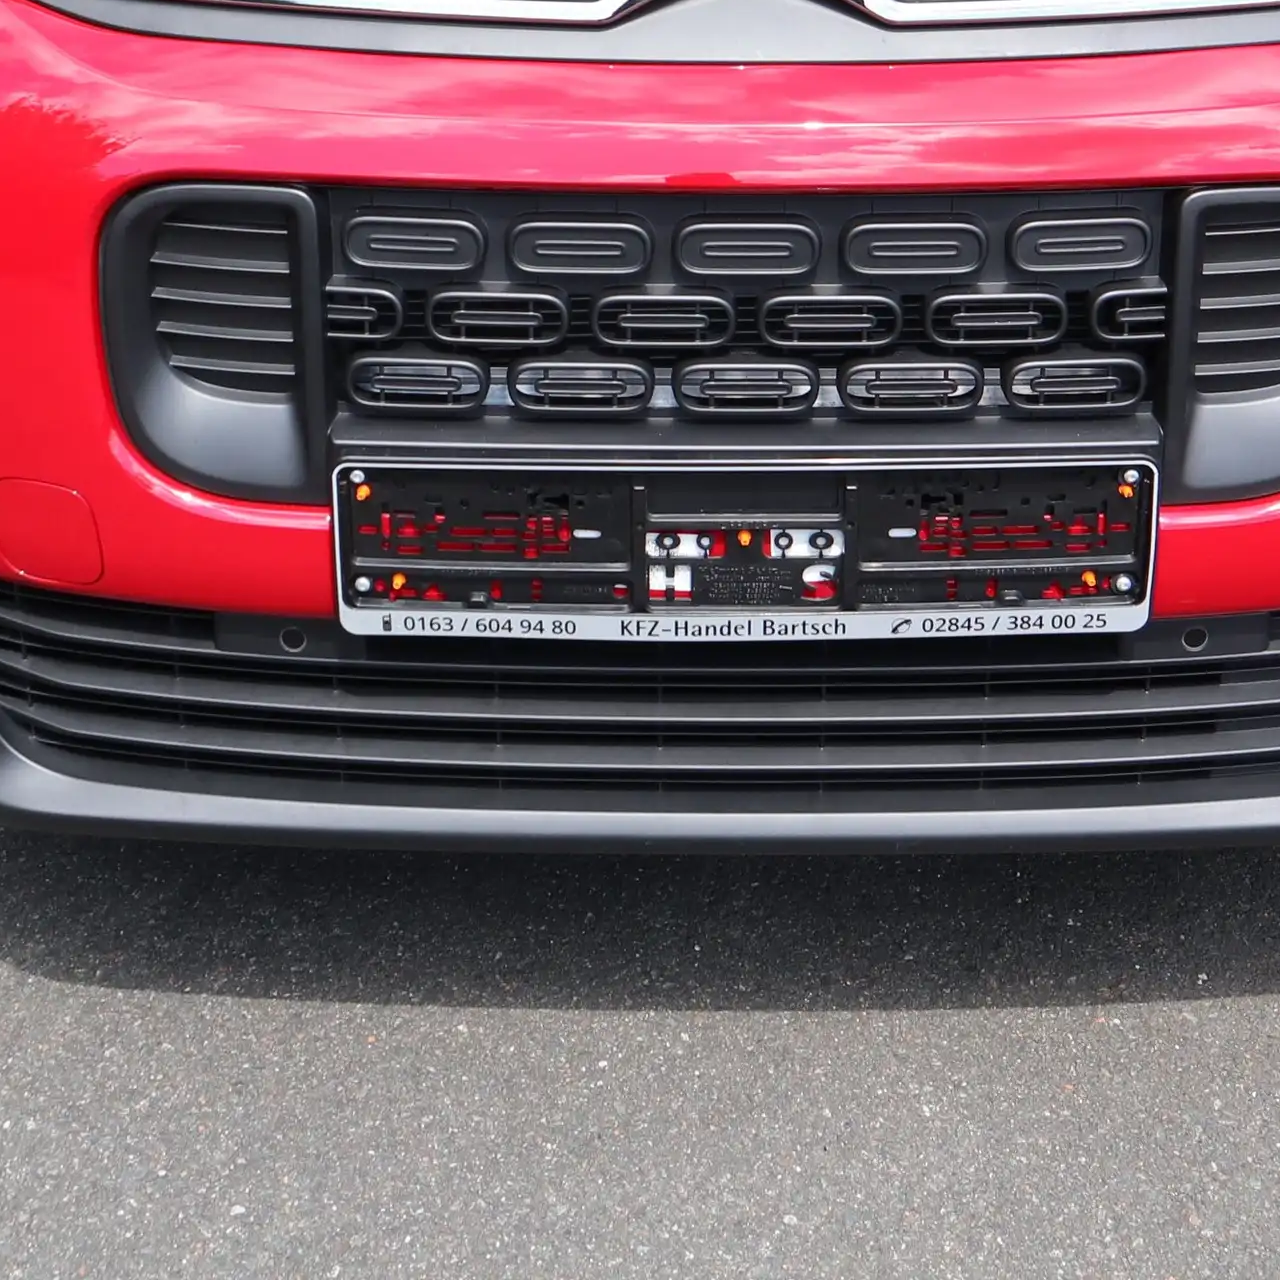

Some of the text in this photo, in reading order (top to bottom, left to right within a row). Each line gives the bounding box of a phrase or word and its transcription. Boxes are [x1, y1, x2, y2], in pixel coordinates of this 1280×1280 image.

[403, 616, 577, 635] 0163 / 604 94 80
[620, 618, 847, 637] KFZ-Handel Bartsch
[921, 612, 1108, 633] 02845 / 384 00 25
